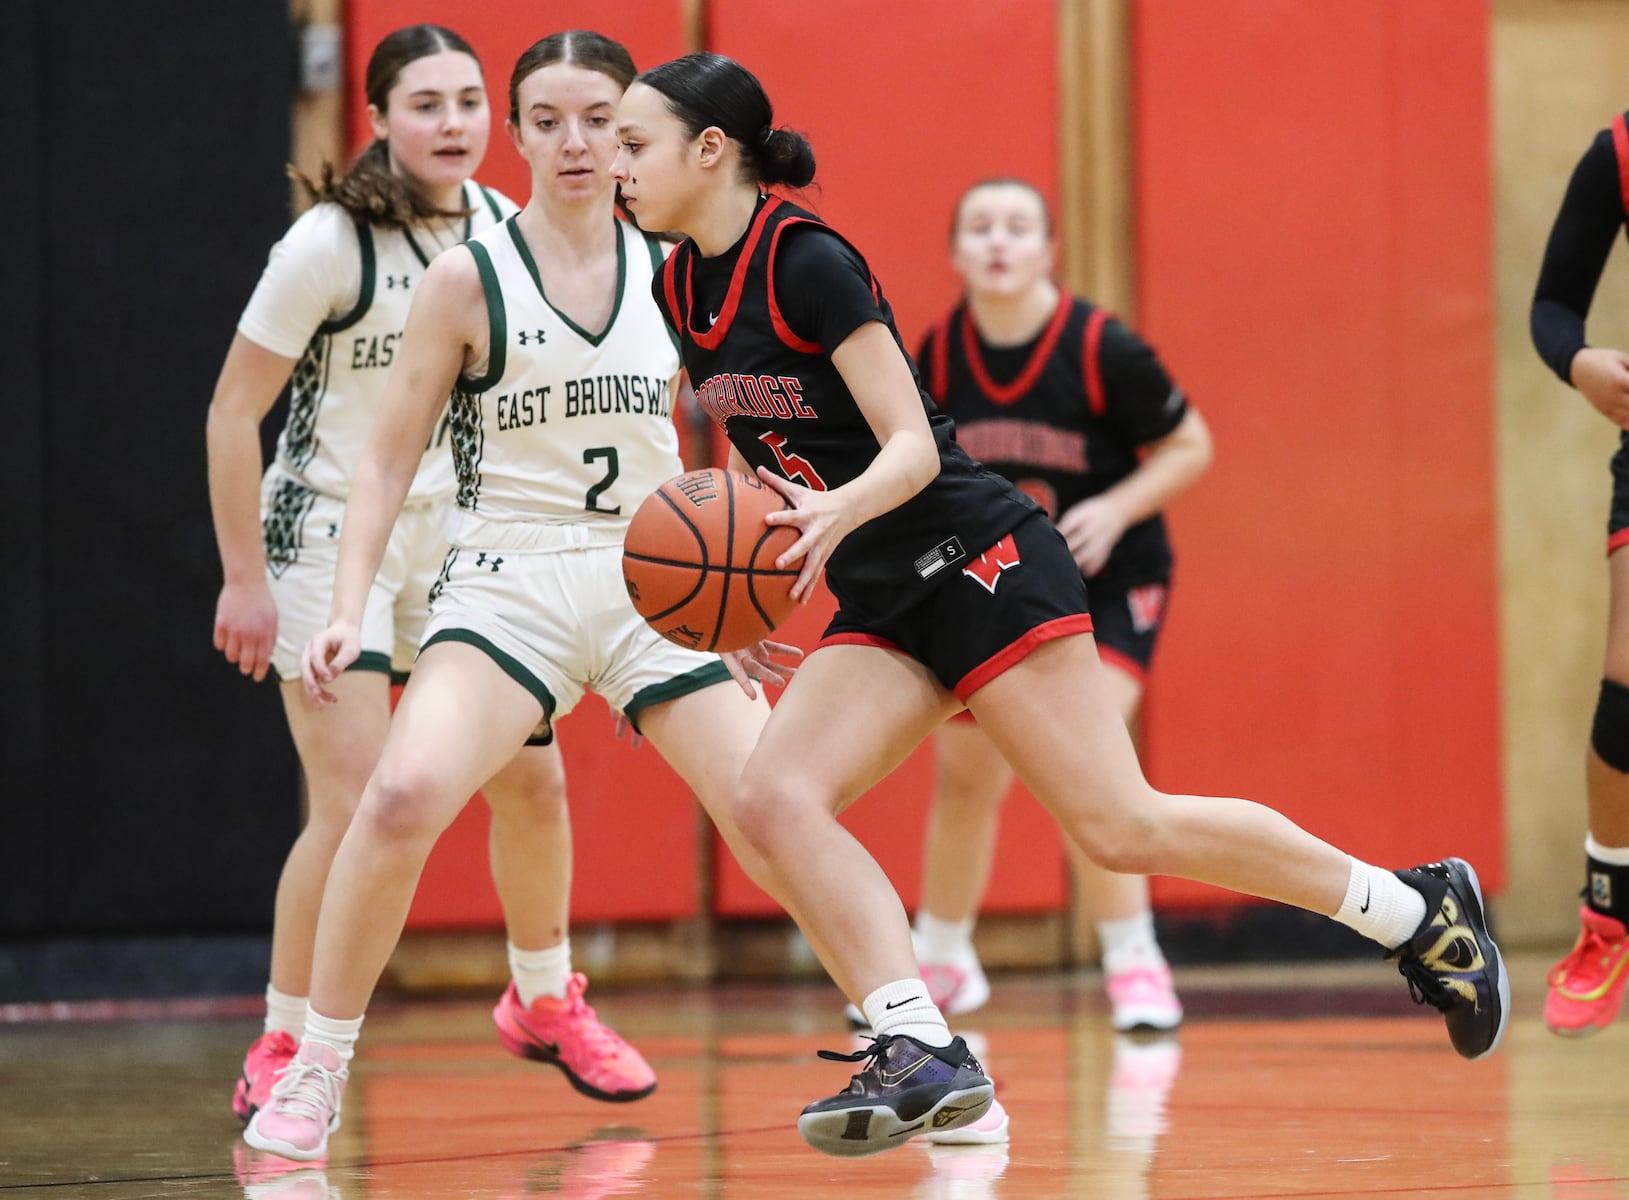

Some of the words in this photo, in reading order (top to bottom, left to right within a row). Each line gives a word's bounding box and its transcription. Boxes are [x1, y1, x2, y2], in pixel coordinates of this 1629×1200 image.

[351, 331, 403, 370] EAS
[498, 386, 551, 431] EAST
[582, 446, 621, 515] 2
[757, 430, 827, 492] 5
[946, 545, 956, 556] S
